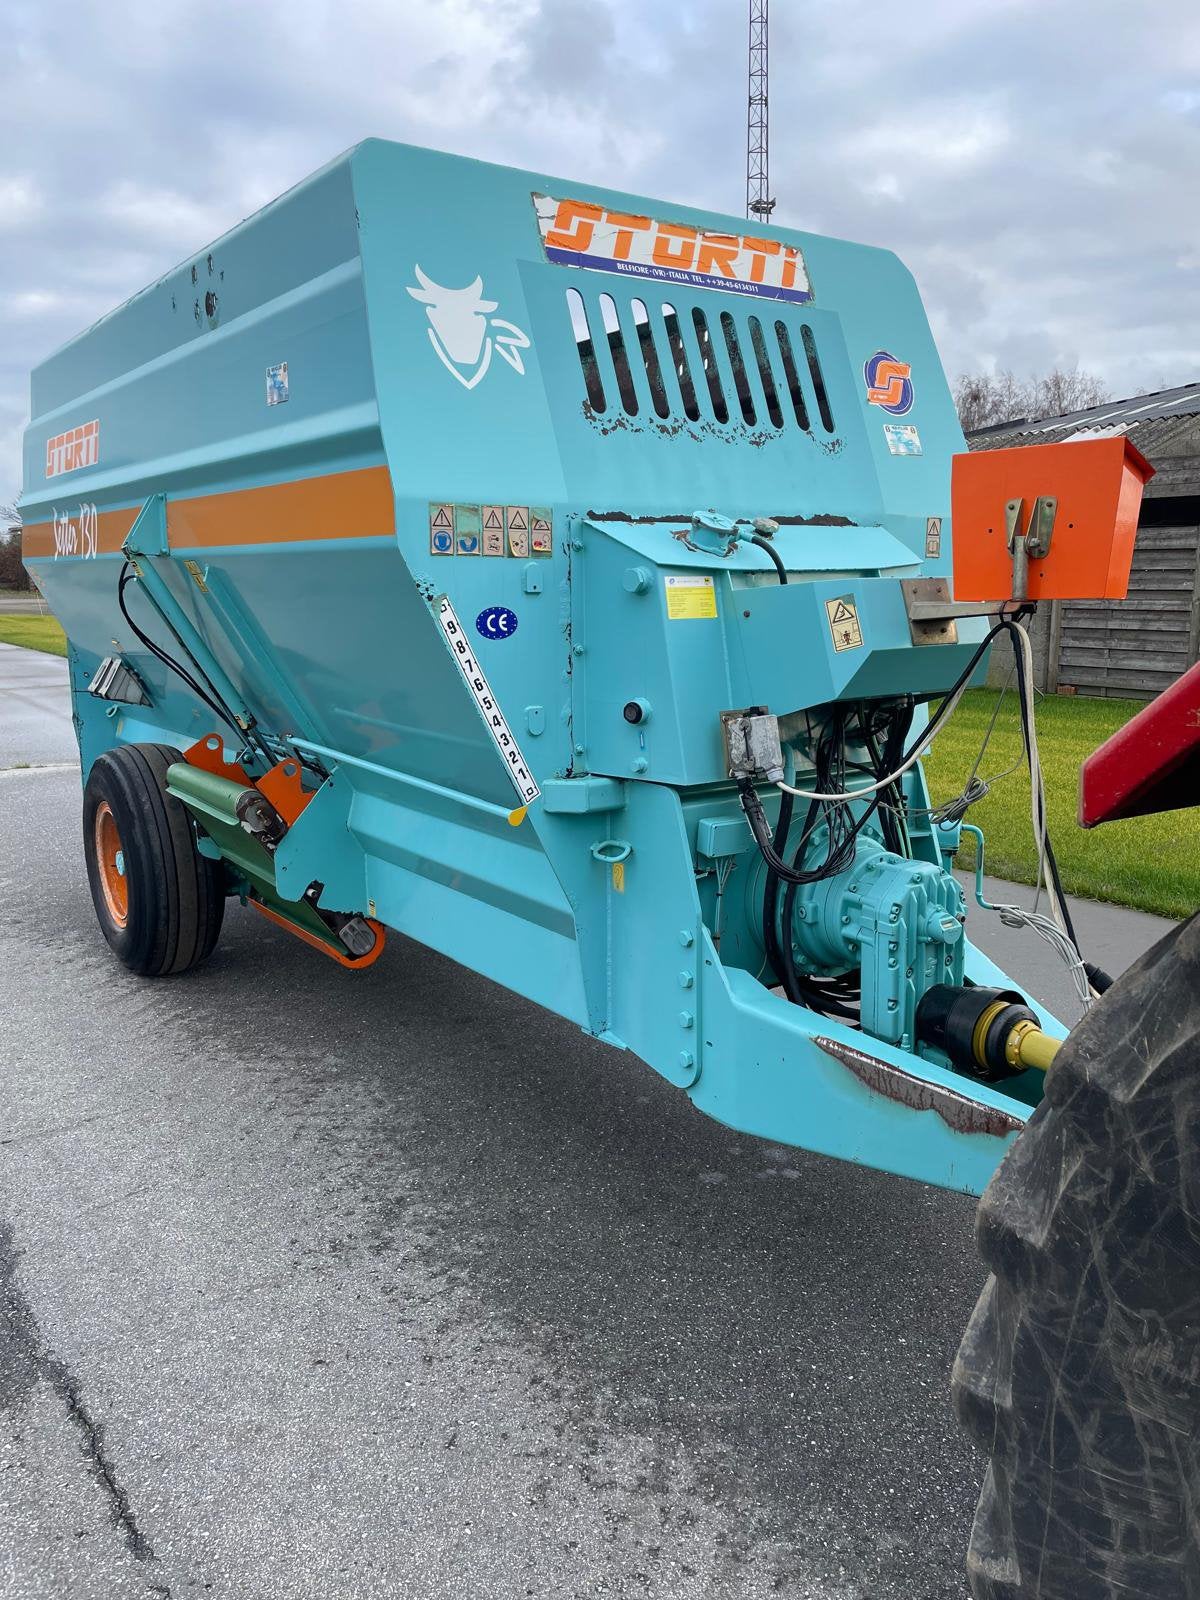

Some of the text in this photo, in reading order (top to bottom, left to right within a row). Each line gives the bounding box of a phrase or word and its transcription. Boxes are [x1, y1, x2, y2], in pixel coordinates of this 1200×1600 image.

[79, 503, 98, 560] 130
[487, 614, 508, 632] CE
[446, 620, 457, 635] 9
[455, 639, 466, 655] 8
[465, 658, 474, 673] 7
[473, 677, 484, 692] 6
[482, 696, 492, 710] 5
[491, 714, 501, 728] 4
[500, 732, 510, 747] 3
[508, 750, 519, 765] 2
[518, 767, 527, 780] 1
